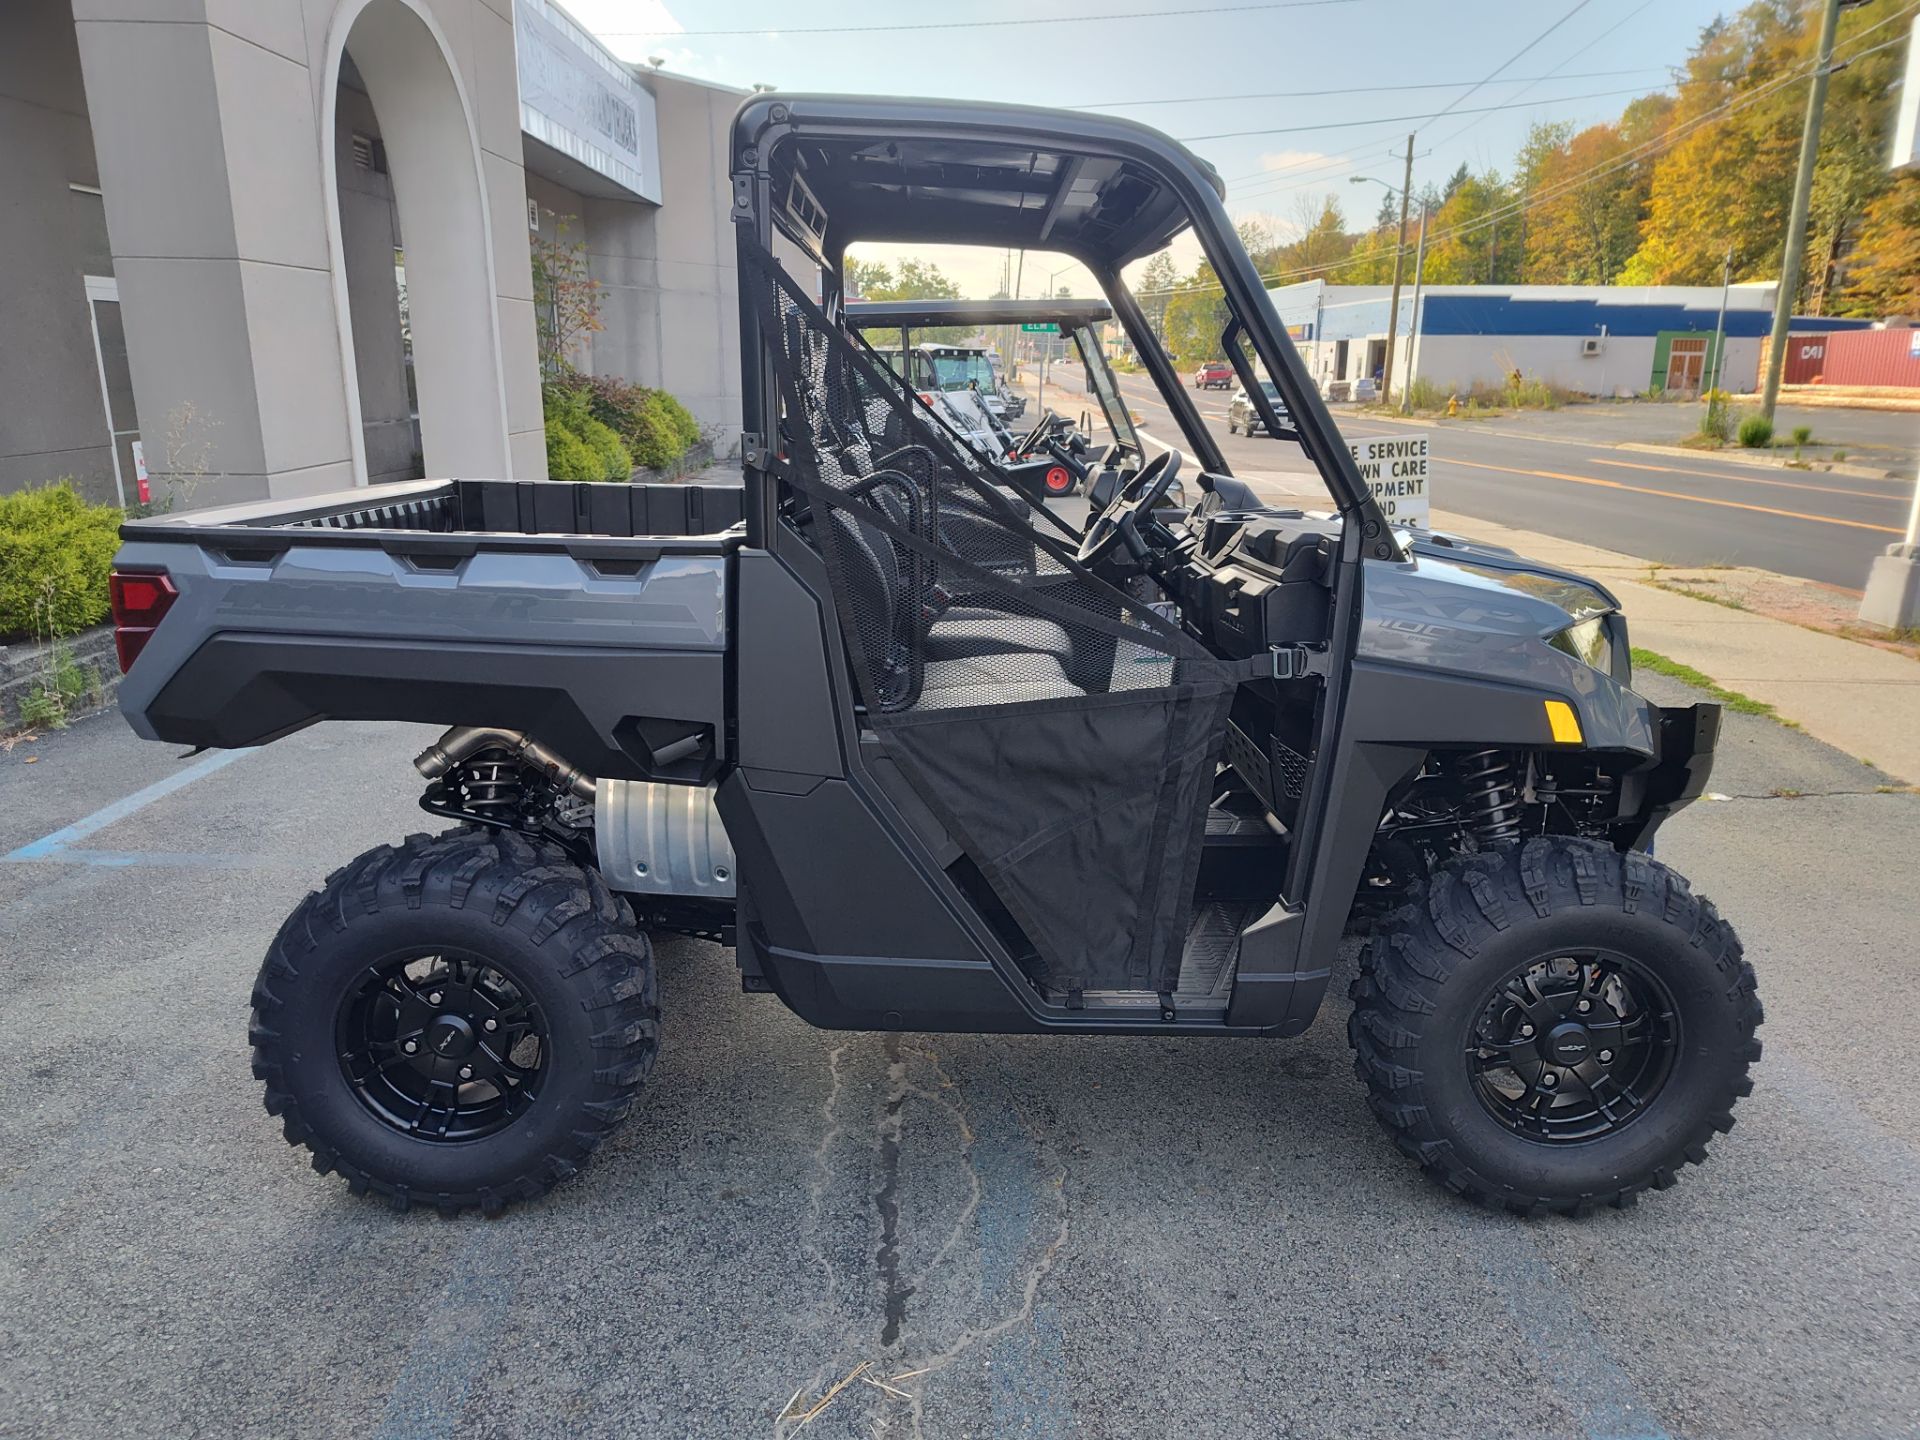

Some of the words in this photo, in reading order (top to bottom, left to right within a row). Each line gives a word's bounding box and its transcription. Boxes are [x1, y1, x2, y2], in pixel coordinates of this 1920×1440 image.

[1801, 345, 1822, 359] CAI
[1368, 440, 1428, 460] SERVICE
[1359, 463, 1381, 479] WN
[1391, 460, 1427, 478] CARE
[1378, 500, 1396, 516] ND
